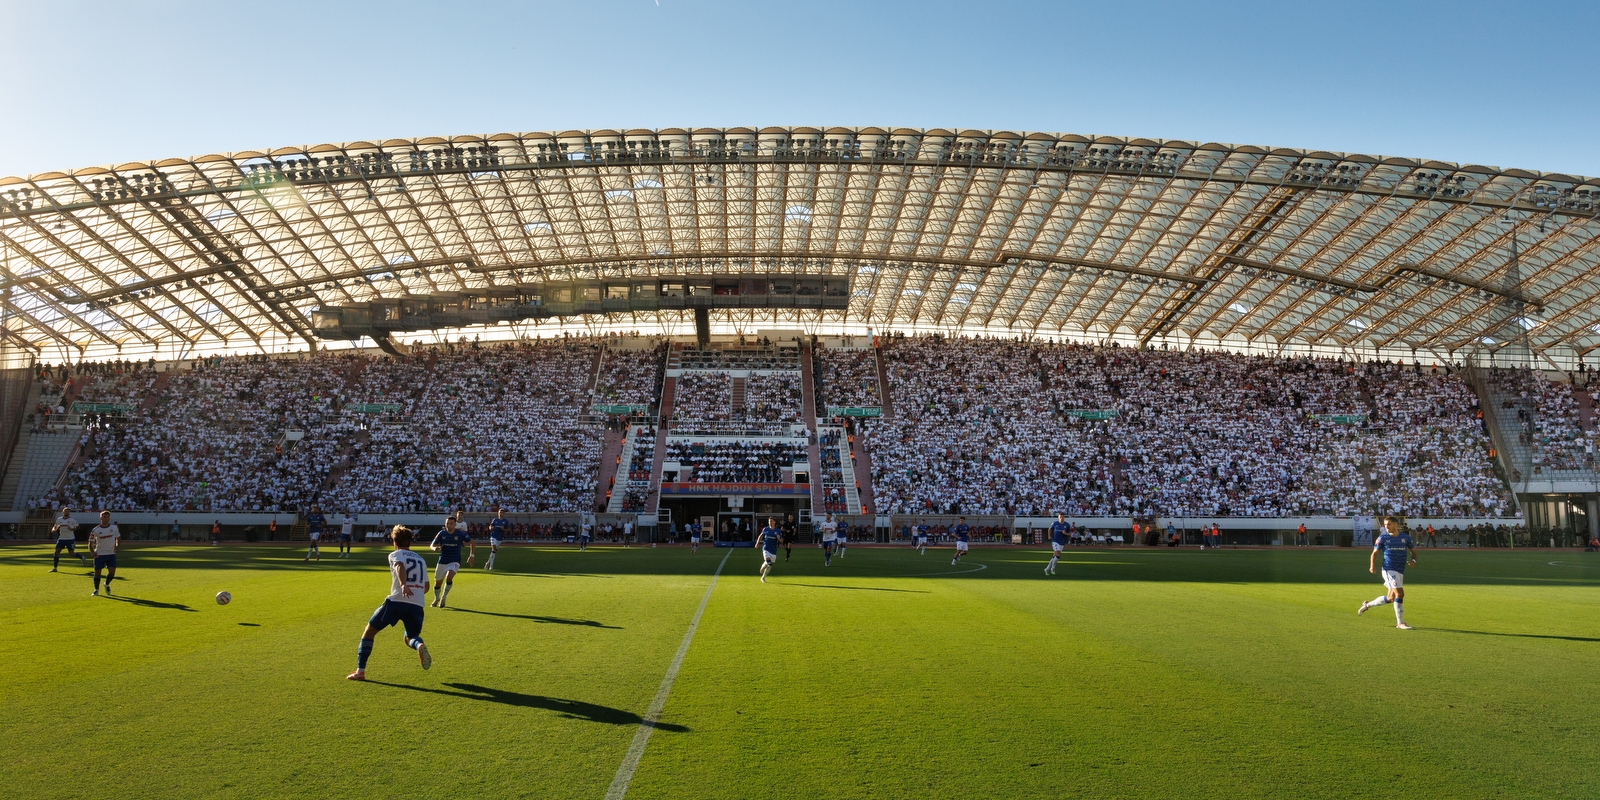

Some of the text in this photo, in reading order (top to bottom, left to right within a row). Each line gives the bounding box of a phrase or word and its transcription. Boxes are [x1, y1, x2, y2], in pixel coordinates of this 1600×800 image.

[689, 484, 710, 492] HNK
[712, 484, 754, 492] HAJDUK
[406, 558, 424, 583] 21
